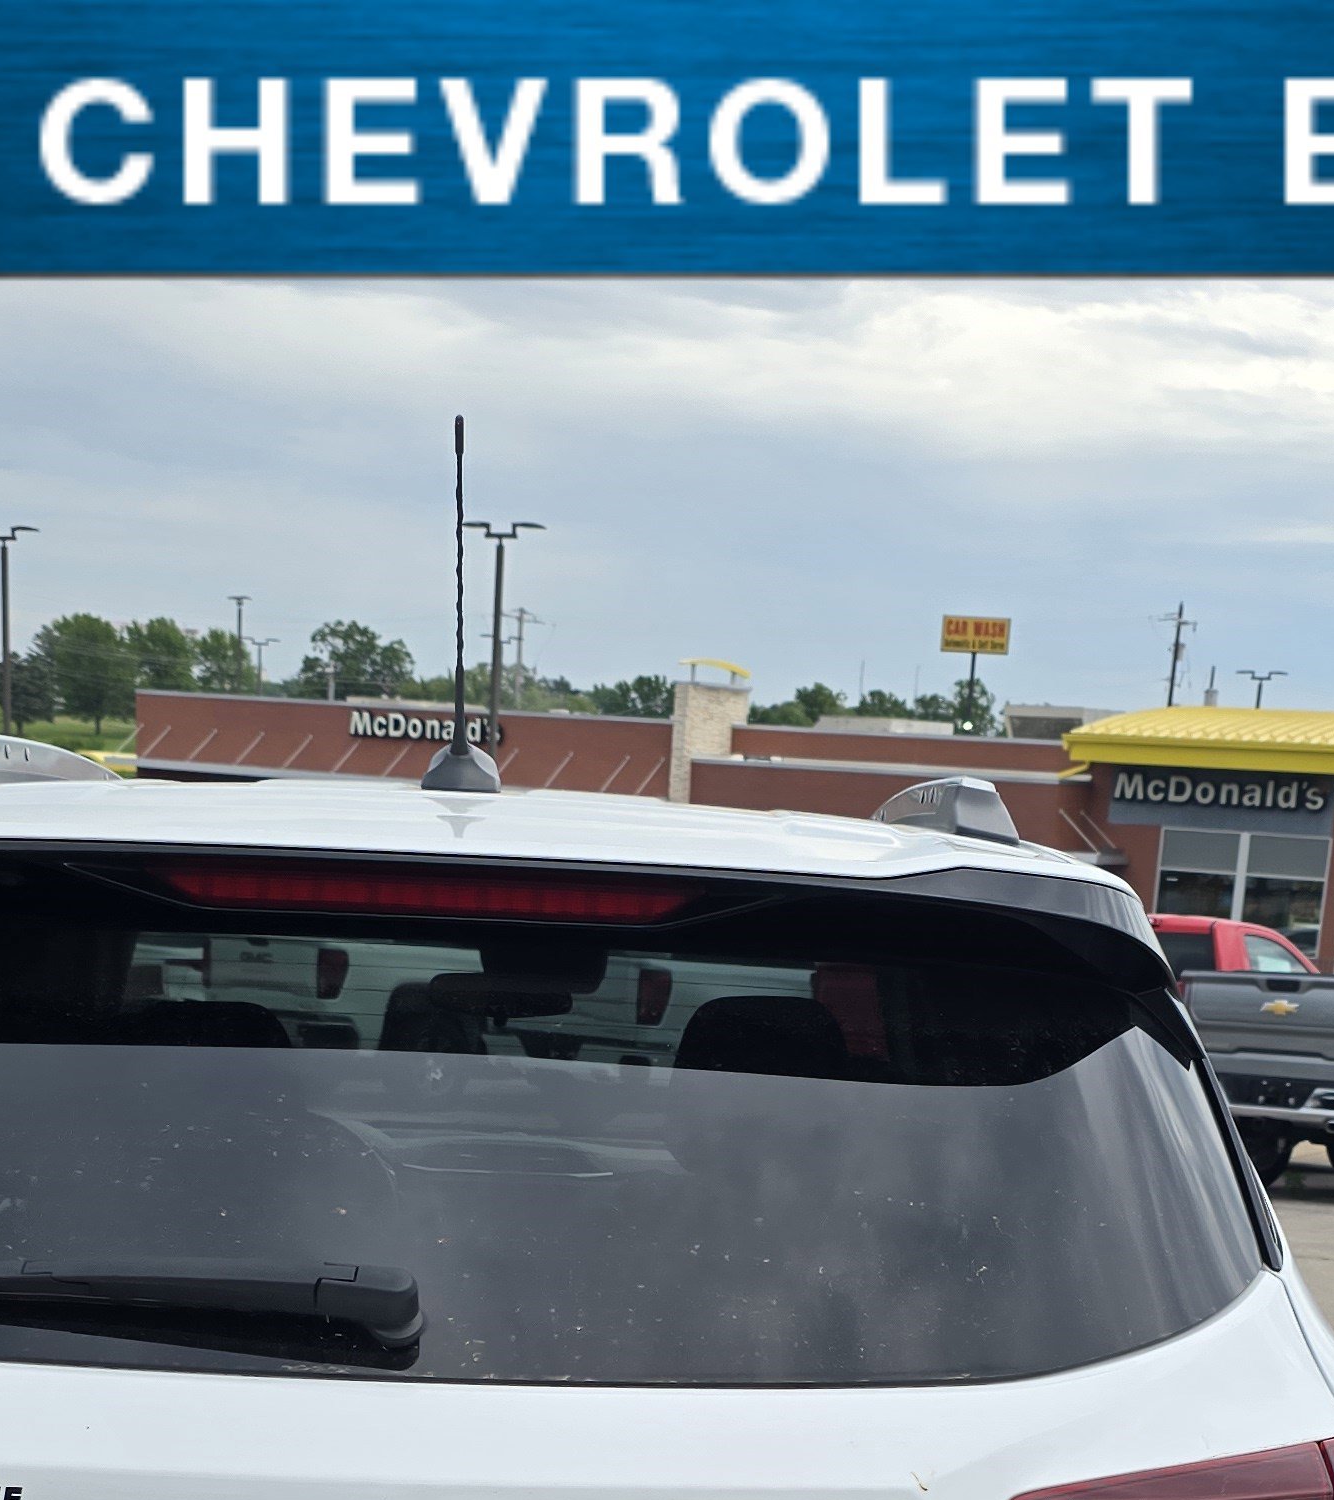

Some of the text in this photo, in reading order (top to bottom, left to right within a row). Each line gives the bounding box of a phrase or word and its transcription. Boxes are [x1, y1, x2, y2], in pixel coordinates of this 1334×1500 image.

[946, 618, 1005, 638] CAR WASH
[349, 710, 501, 744] McDonad'
[1113, 771, 1325, 811] McDonald's
